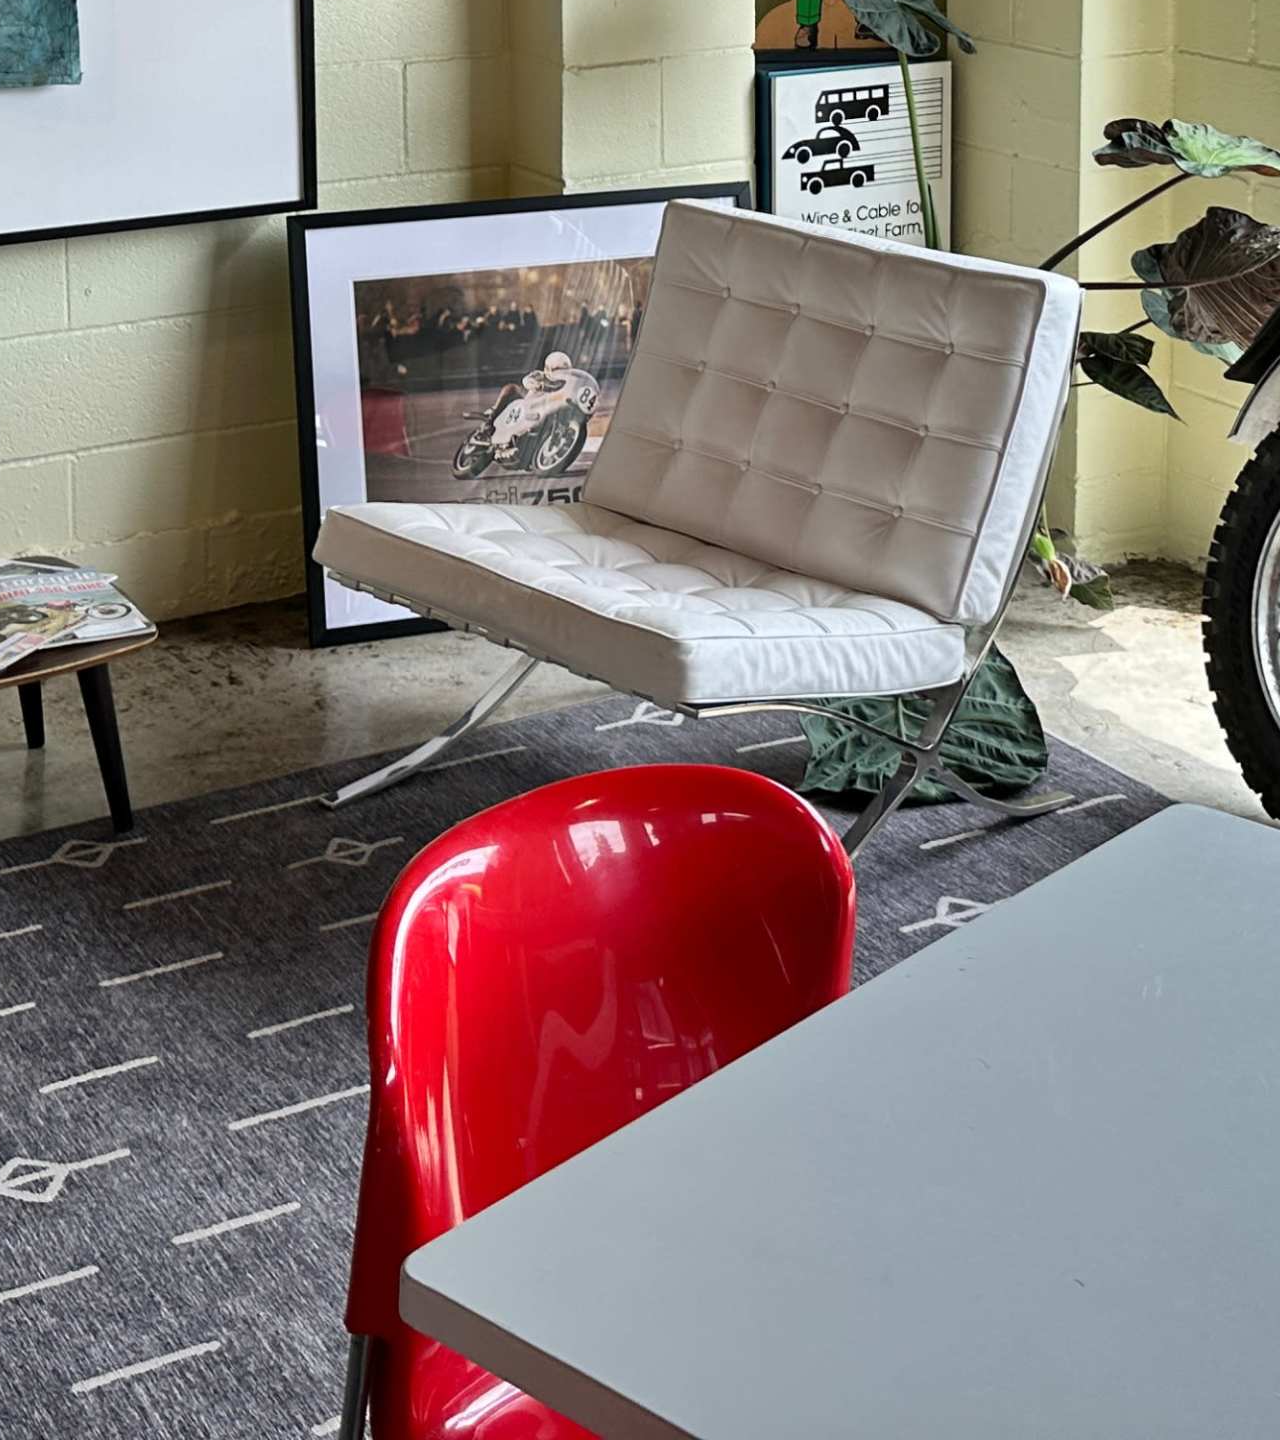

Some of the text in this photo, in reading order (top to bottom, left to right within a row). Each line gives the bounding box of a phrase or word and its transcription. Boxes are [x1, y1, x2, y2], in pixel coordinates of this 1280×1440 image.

[801, 199, 920, 225] Wire & Cable fo
[579, 387, 597, 411] 84
